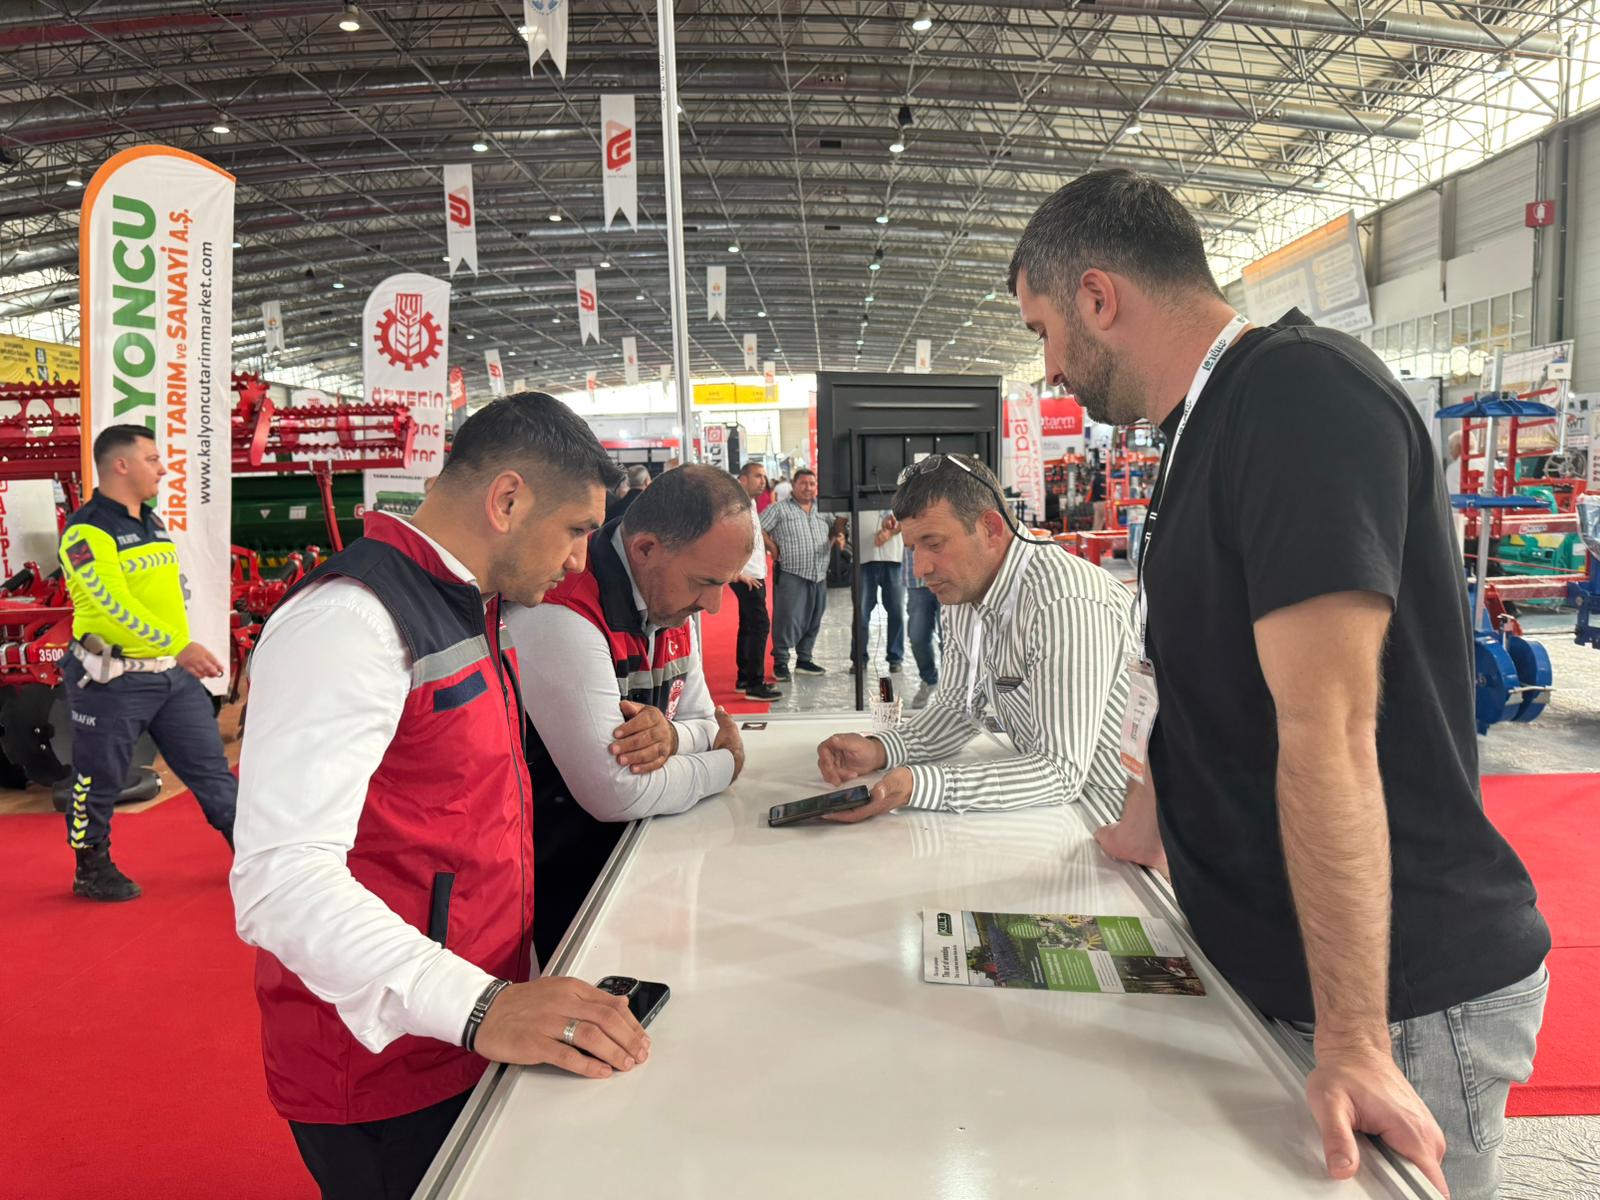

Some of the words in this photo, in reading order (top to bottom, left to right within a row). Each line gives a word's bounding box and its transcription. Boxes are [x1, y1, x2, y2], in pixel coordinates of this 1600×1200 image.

[160, 246, 188, 340] SANAYİ
[175, 342, 187, 360] ve
[197, 241, 214, 504] www.kalyoncutarimmarket.com
[167, 362, 187, 437] TARIM
[162, 444, 187, 532] ZİRAAT
[39, 648, 64, 662] 3500
